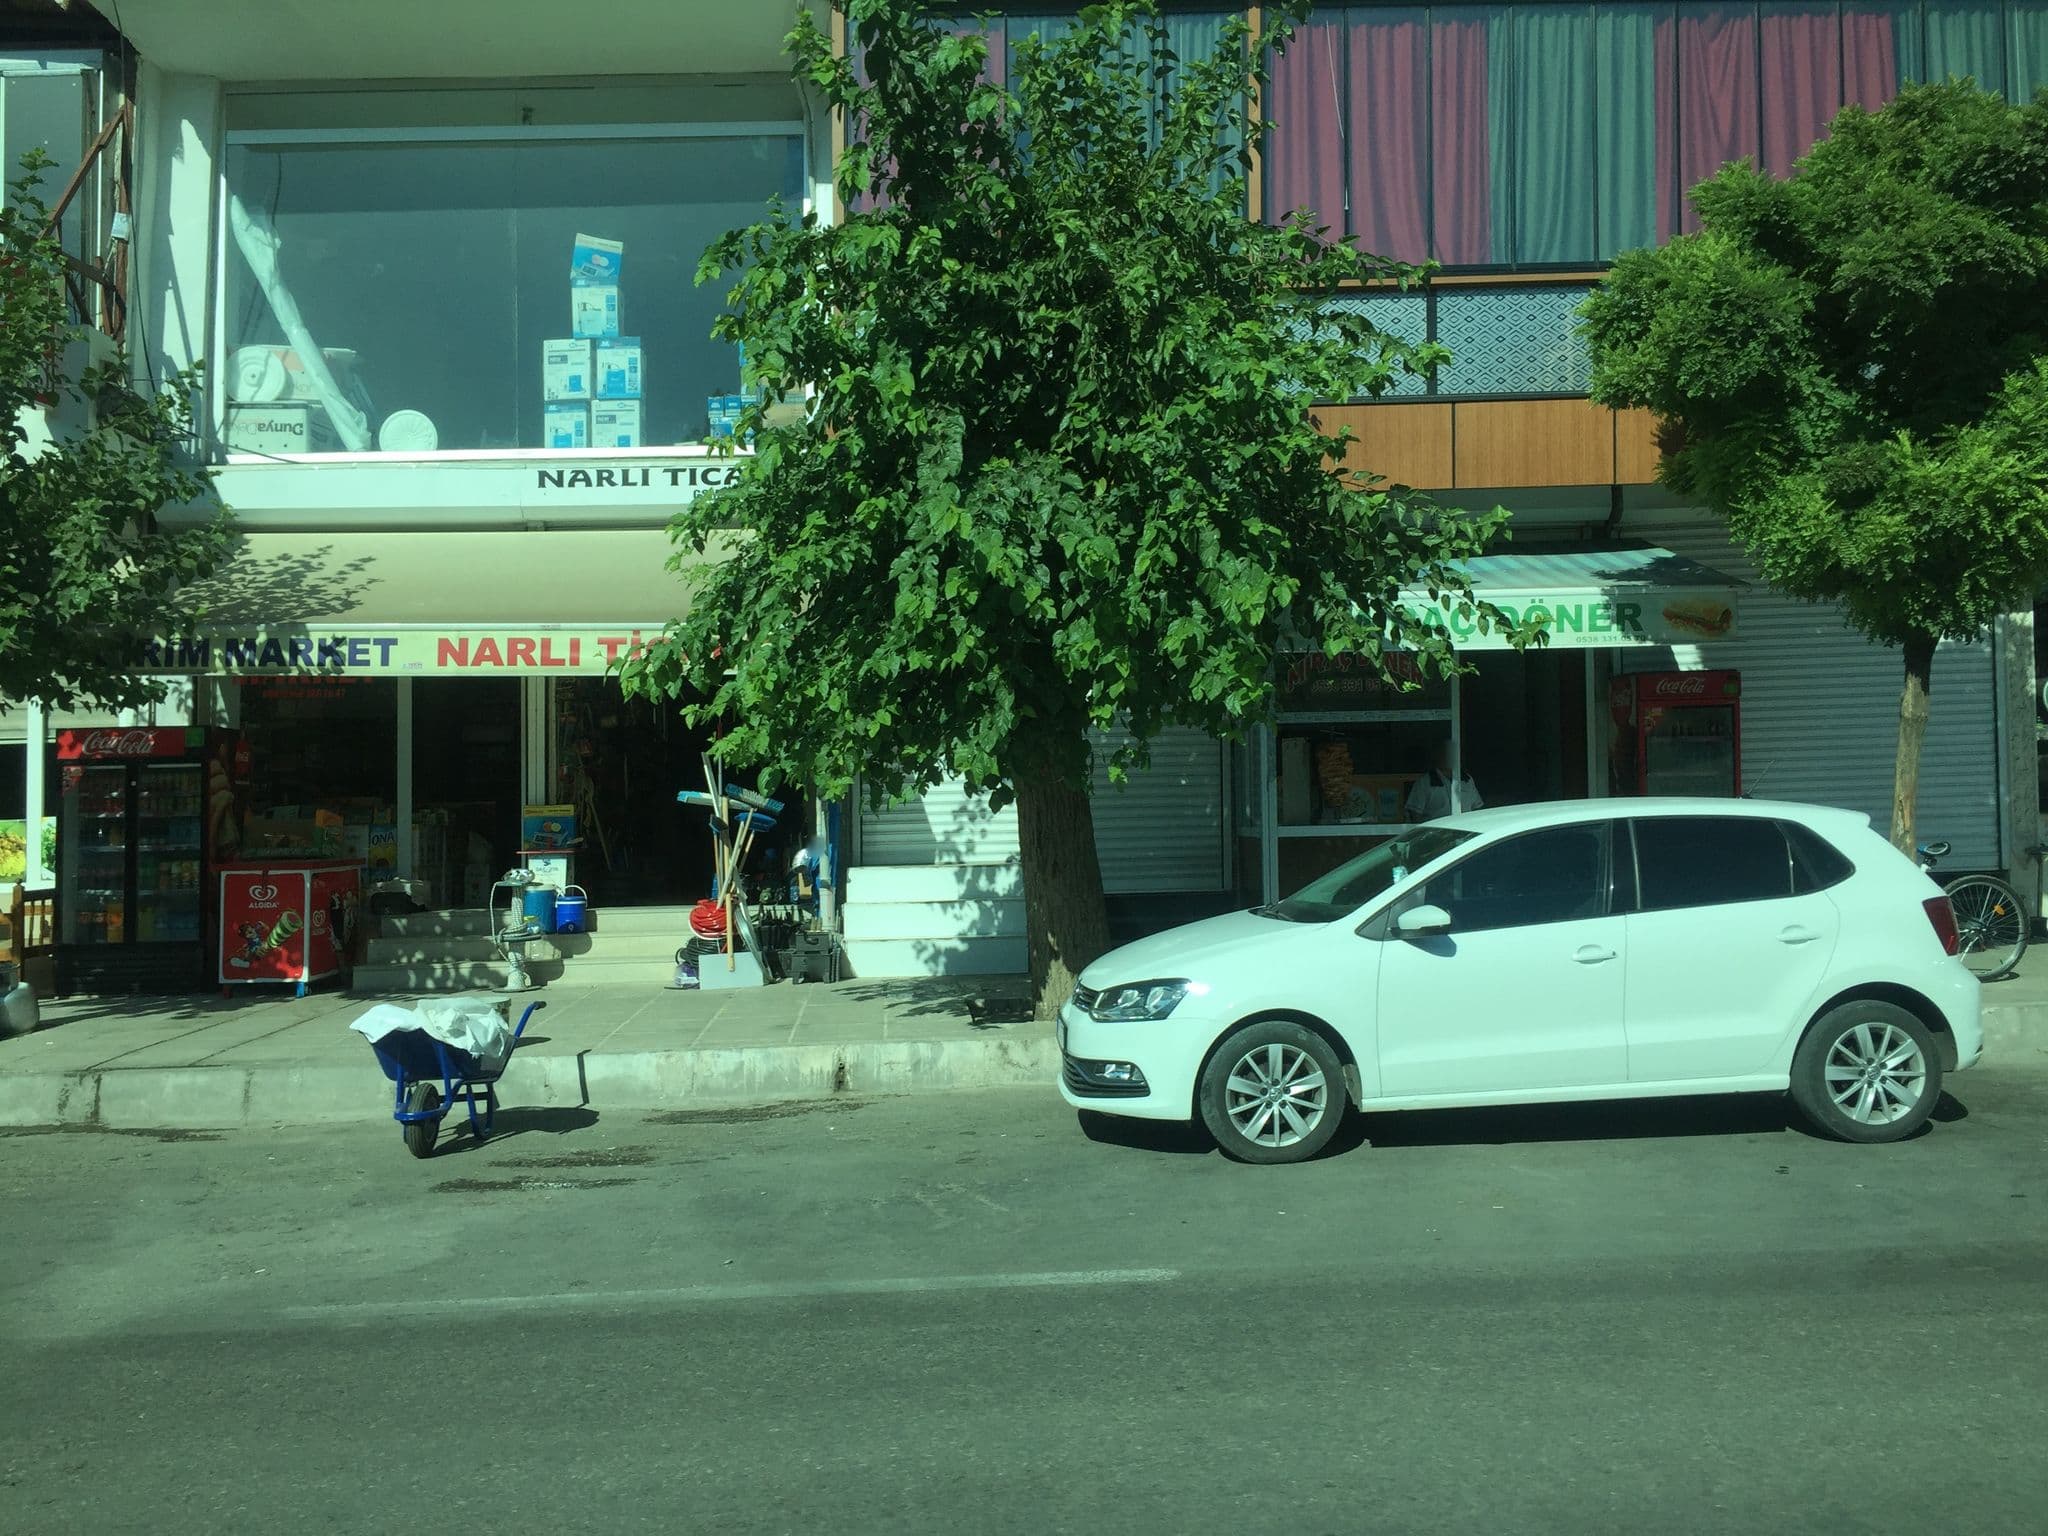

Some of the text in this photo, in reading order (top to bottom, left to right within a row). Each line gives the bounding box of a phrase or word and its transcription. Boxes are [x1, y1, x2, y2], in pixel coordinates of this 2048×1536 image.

[537, 468, 650, 488] NARLI
[1494, 598, 1645, 633] DÖNER
[225, 637, 398, 667] MARKET
[437, 637, 580, 667] NARLI
